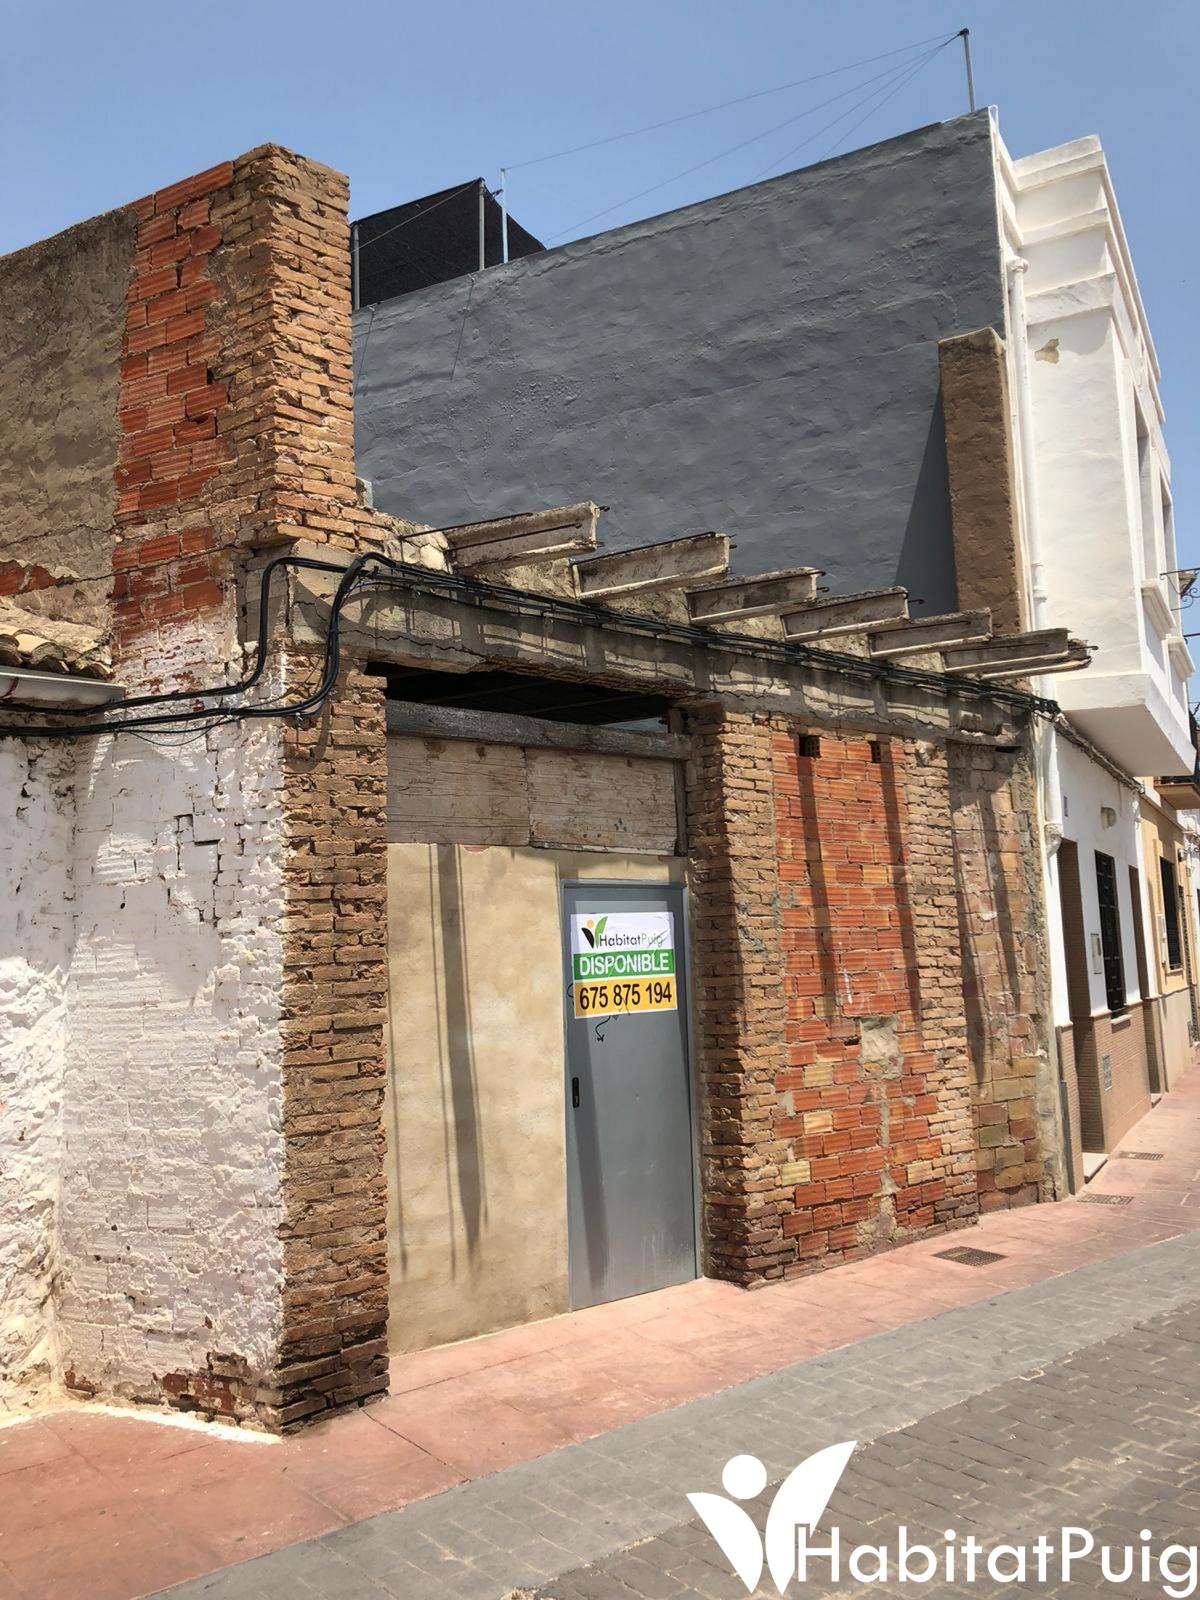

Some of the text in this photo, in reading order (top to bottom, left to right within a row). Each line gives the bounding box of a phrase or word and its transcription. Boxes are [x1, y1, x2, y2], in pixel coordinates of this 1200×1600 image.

[600, 932, 663, 947] HabitatPuig
[579, 953, 669, 976] DISPONIBLE
[579, 981, 672, 1010] 675 875 194
